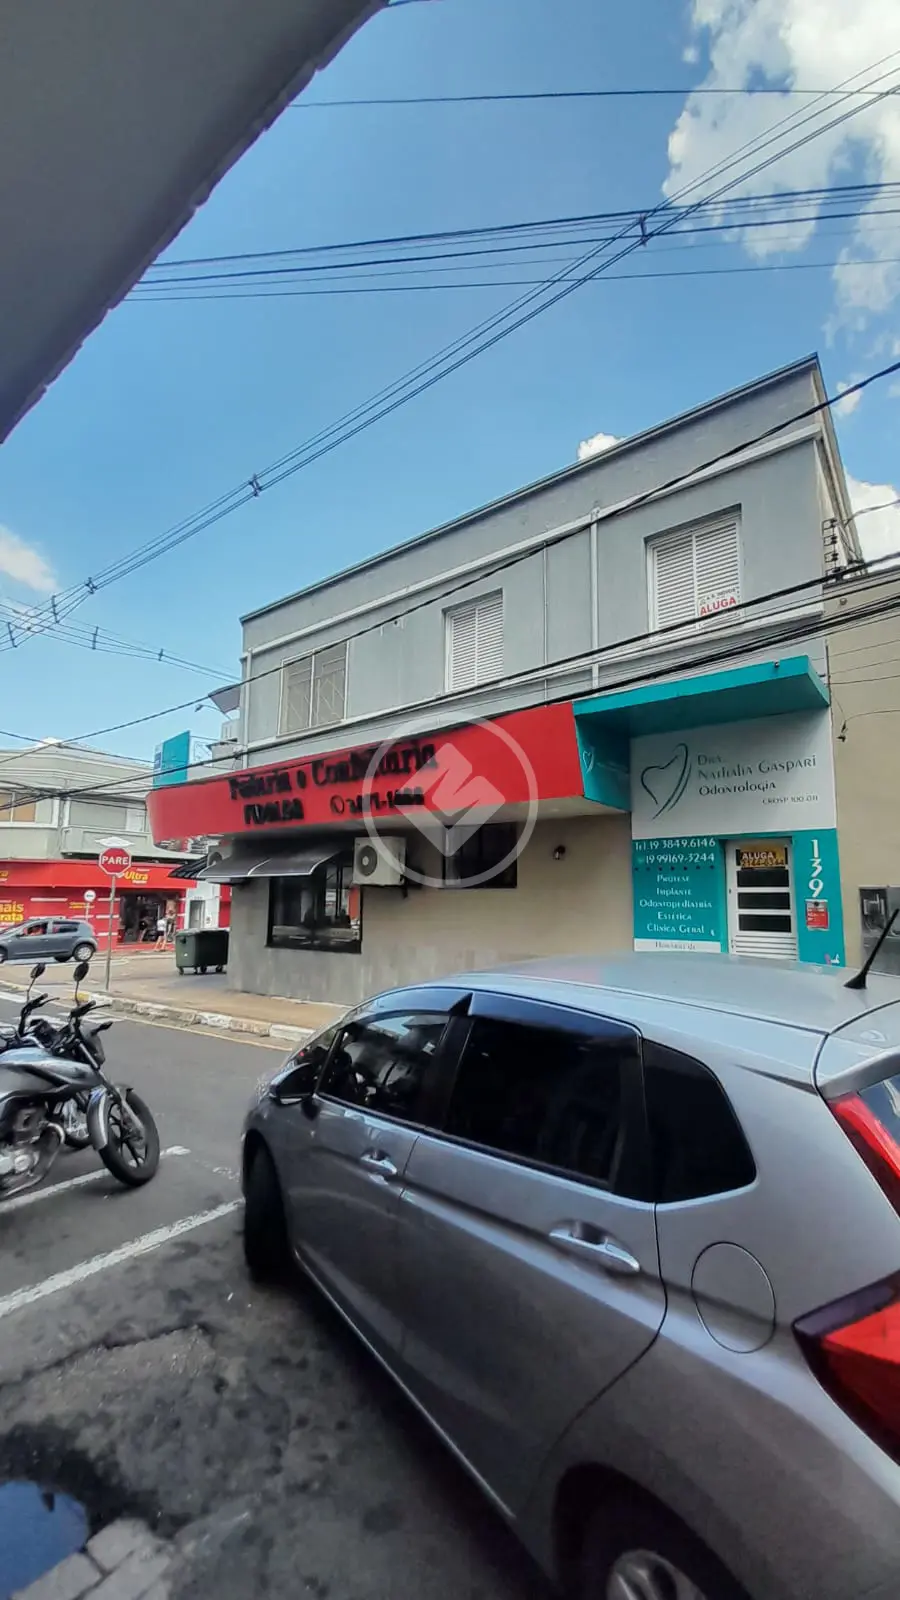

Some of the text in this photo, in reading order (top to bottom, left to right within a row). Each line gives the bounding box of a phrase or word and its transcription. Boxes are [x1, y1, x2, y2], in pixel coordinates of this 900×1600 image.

[700, 596, 737, 616] ALUGA
[699, 779, 777, 796] Odontologia
[101, 855, 129, 865] PARE
[656, 852, 715, 864] 99169-3244
[742, 851, 775, 861] ALUGA
[808, 839, 824, 898] 139
[124, 870, 149, 880] Ultra
